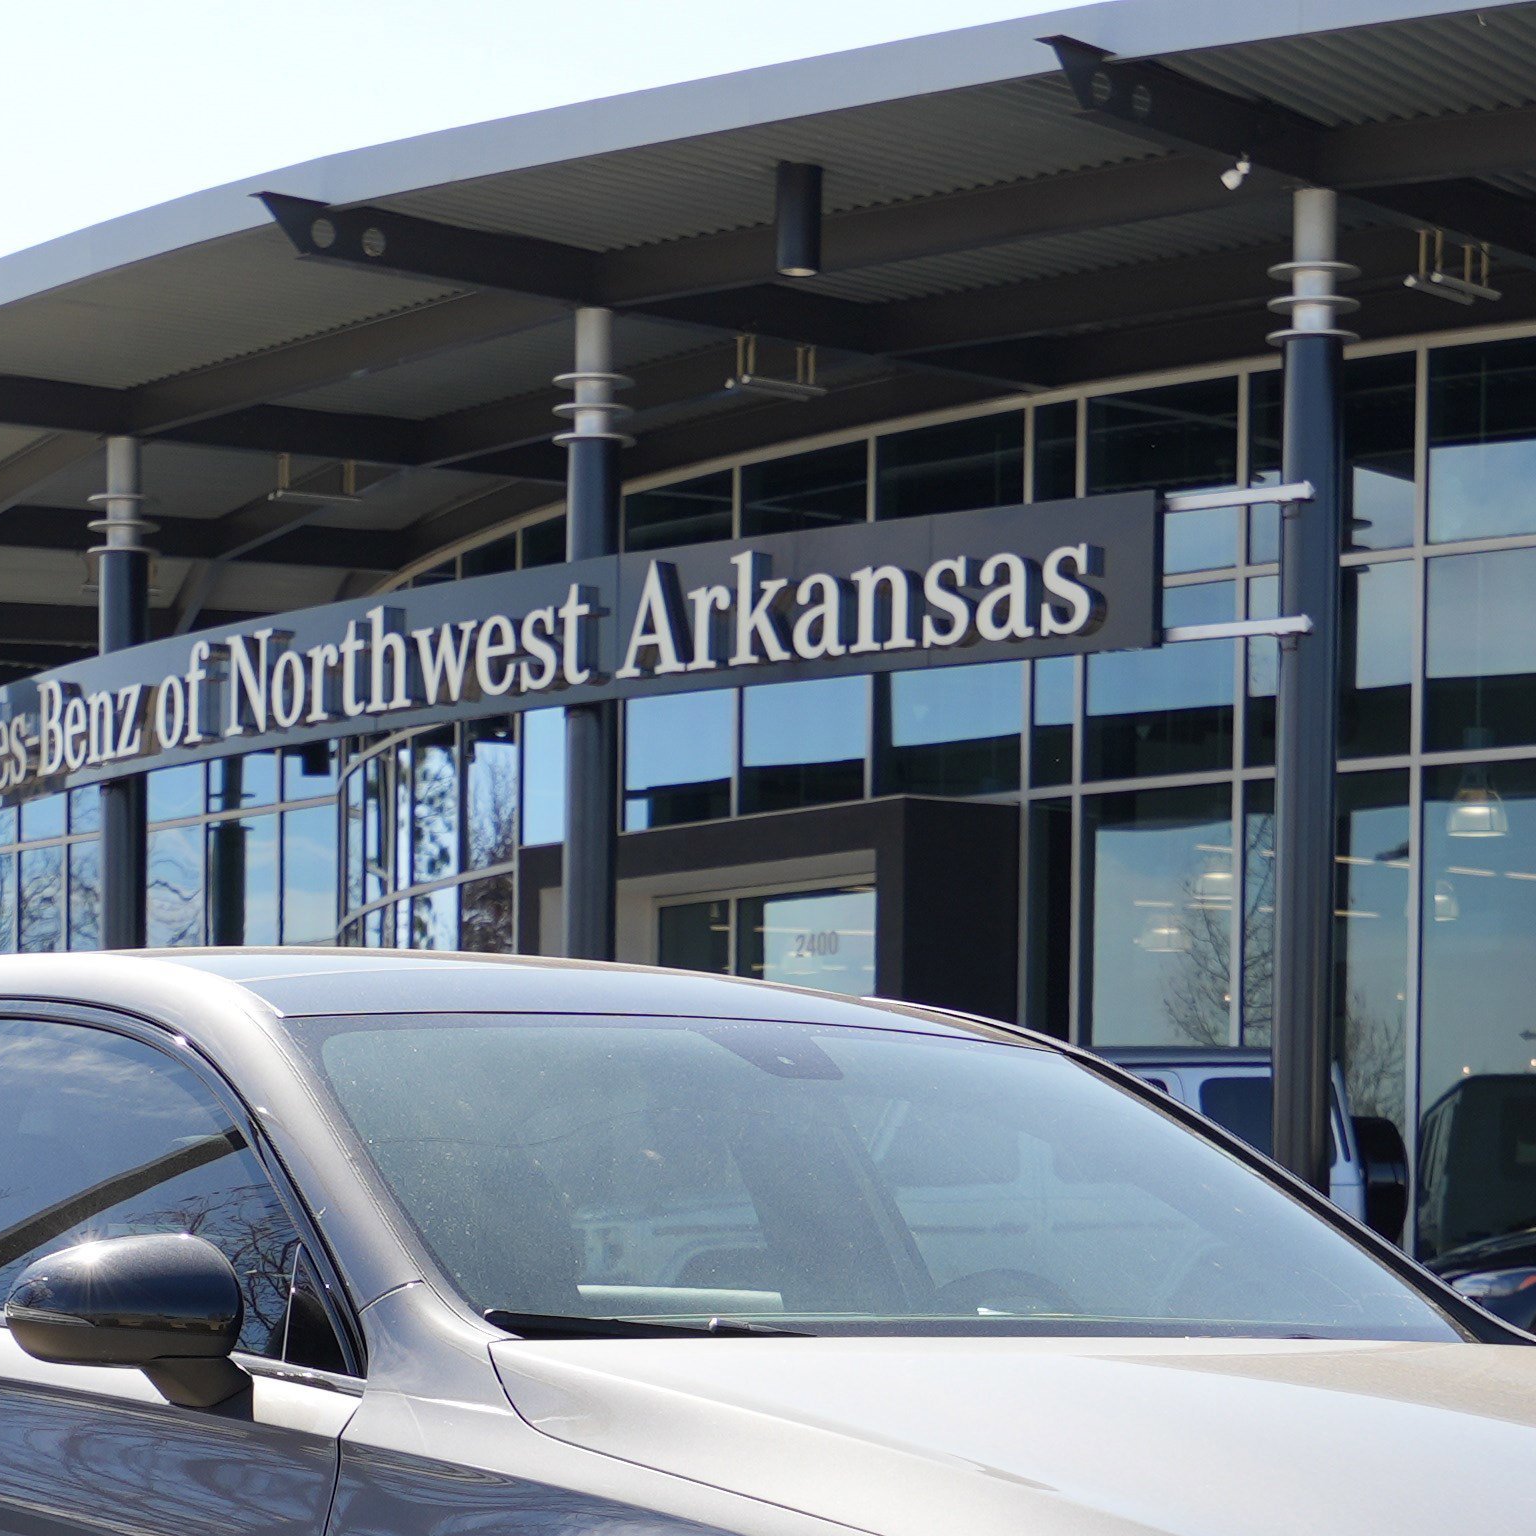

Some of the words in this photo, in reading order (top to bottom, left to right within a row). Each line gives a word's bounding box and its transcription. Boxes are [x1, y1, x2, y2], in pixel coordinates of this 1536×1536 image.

[156, 640, 210, 749] of
[225, 583, 590, 737] Northwest
[616, 542, 1091, 679] Arkansas
[794, 931, 840, 957] 2400
